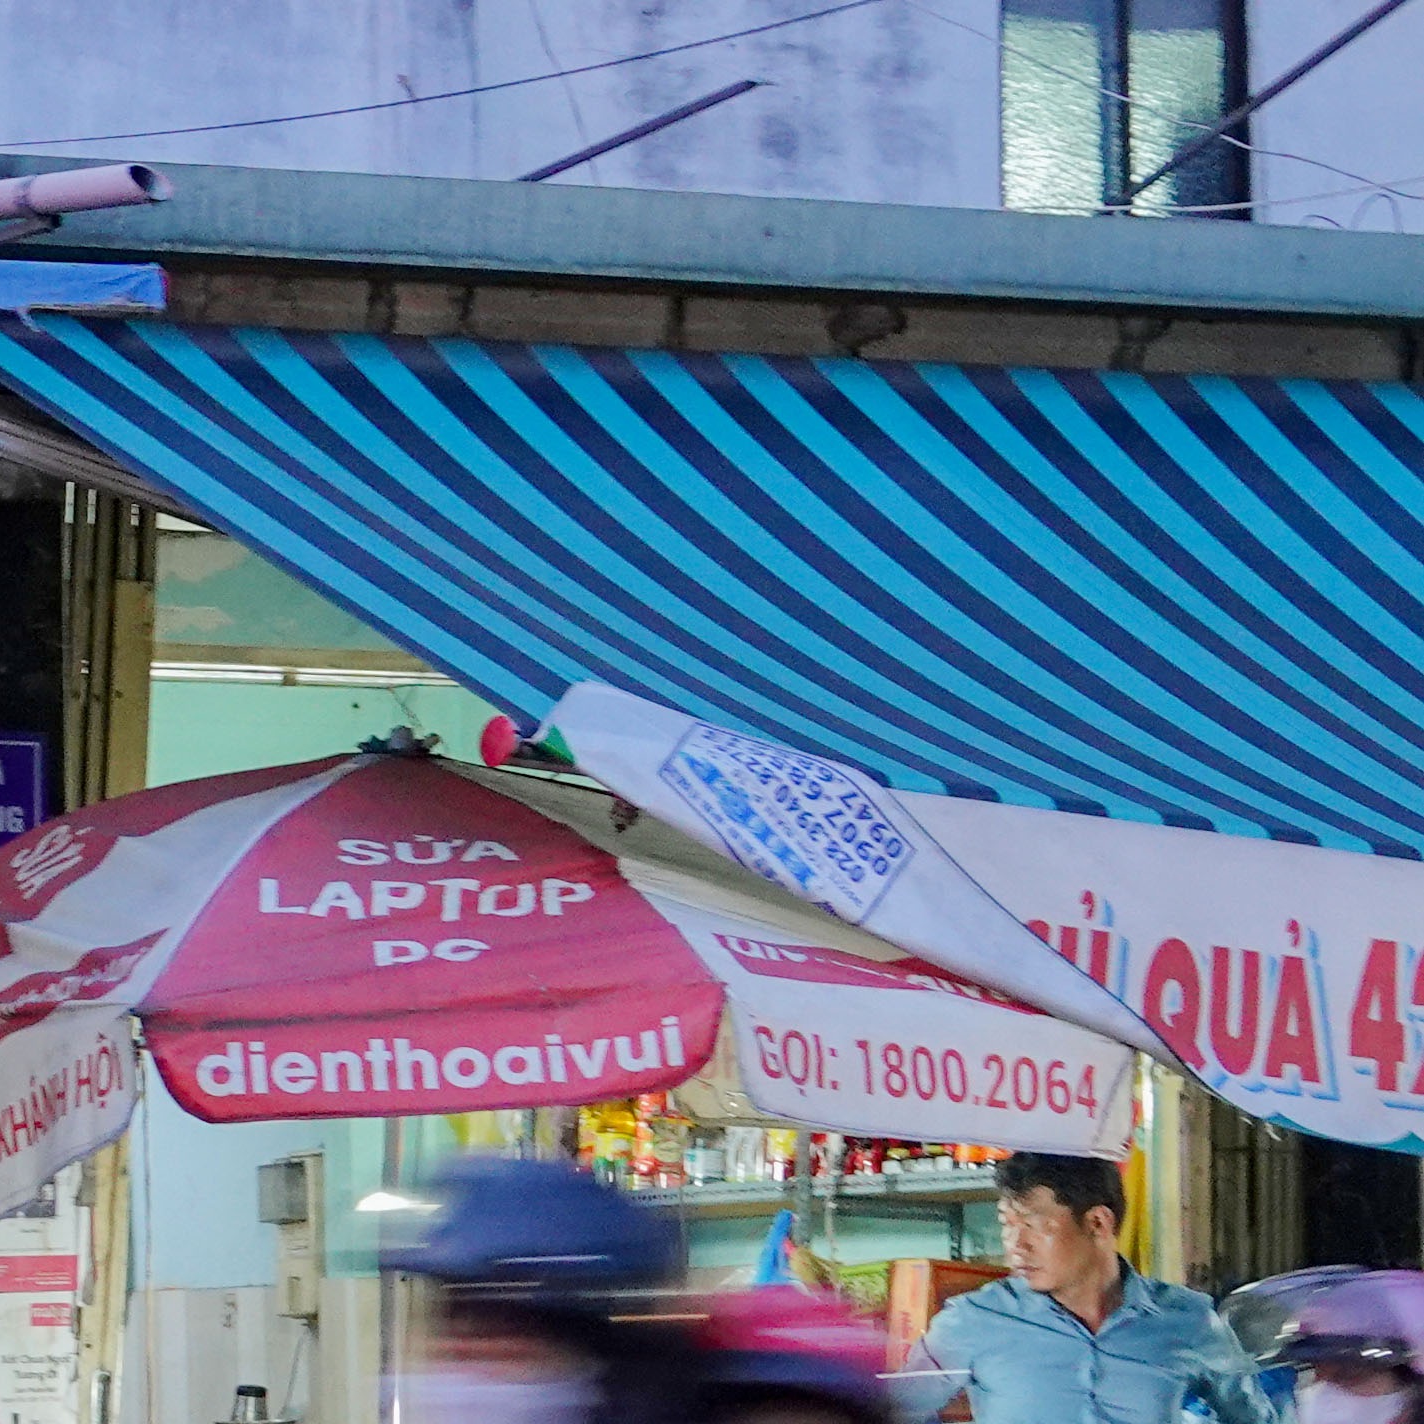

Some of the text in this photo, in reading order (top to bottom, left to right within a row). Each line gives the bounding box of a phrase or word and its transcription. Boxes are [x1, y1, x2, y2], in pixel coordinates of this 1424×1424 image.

[337, 833, 521, 867] SỬA
[258, 877, 595, 922] LAPTOP
[372, 938, 491, 967] PC
[1143, 919, 1321, 1084] QUẢ
[1349, 938, 1424, 1096] 4
[196, 1015, 687, 1097] dienthoaivui
[753, 1025, 1100, 1120] GỌI: 1800.2064
